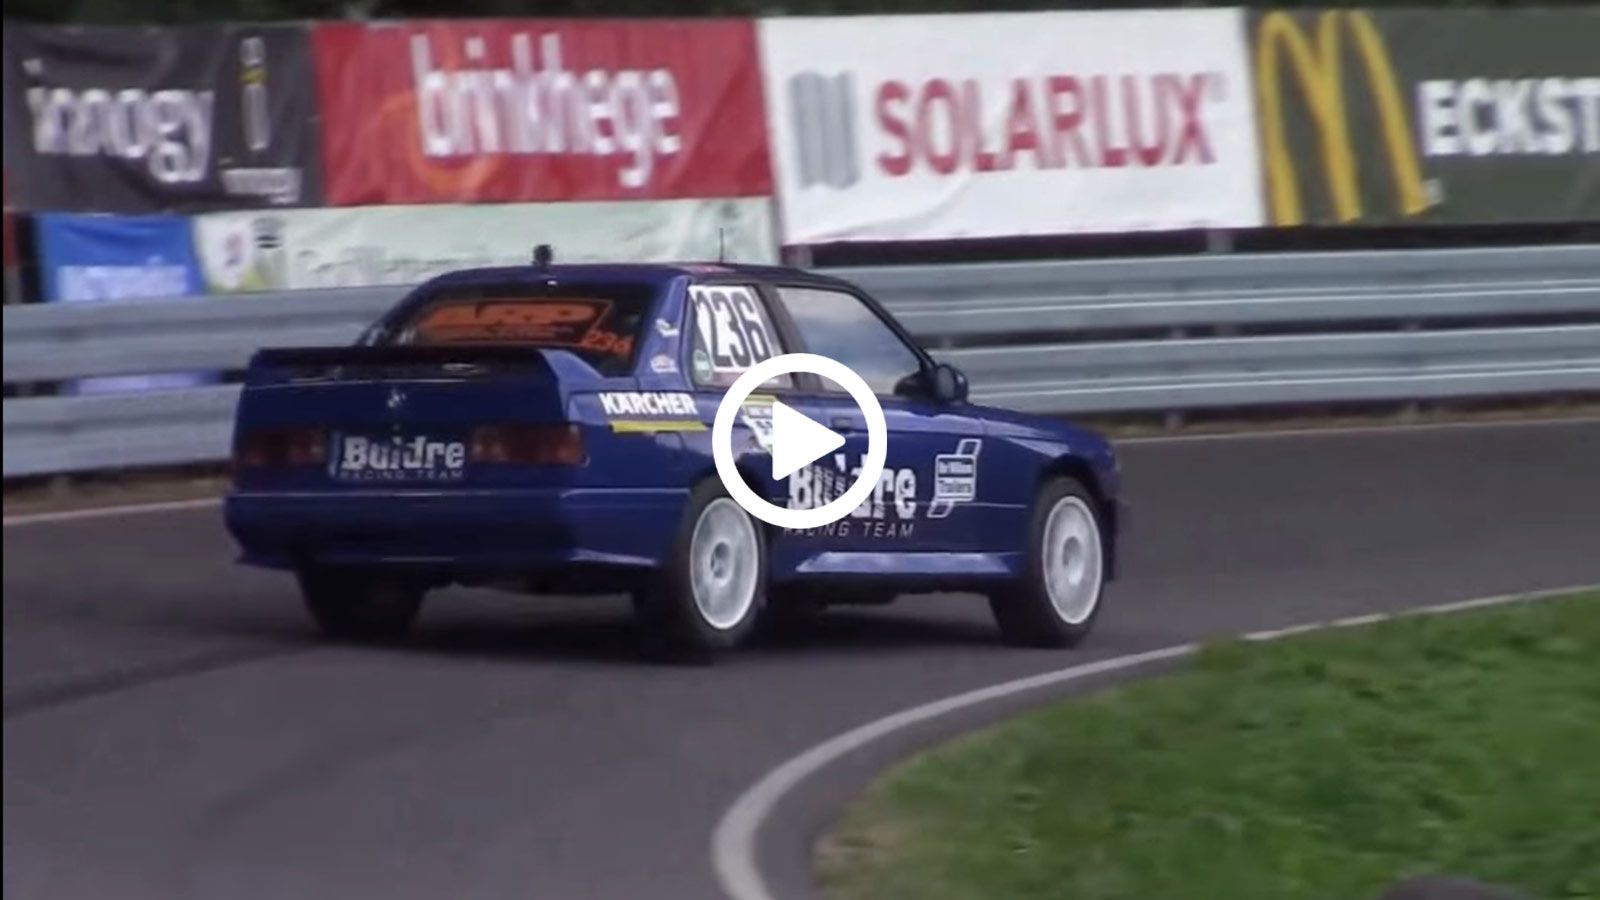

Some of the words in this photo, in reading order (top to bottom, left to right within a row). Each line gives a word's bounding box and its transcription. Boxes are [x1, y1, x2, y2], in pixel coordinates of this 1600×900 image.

[410, 32, 681, 188] brinkhege
[873, 73, 1218, 177] SOLARLUX
[693, 289, 772, 368] 236
[340, 435, 467, 470] Buidre
[416, 469, 464, 480] TEAM
[861, 522, 916, 539] TEAM
